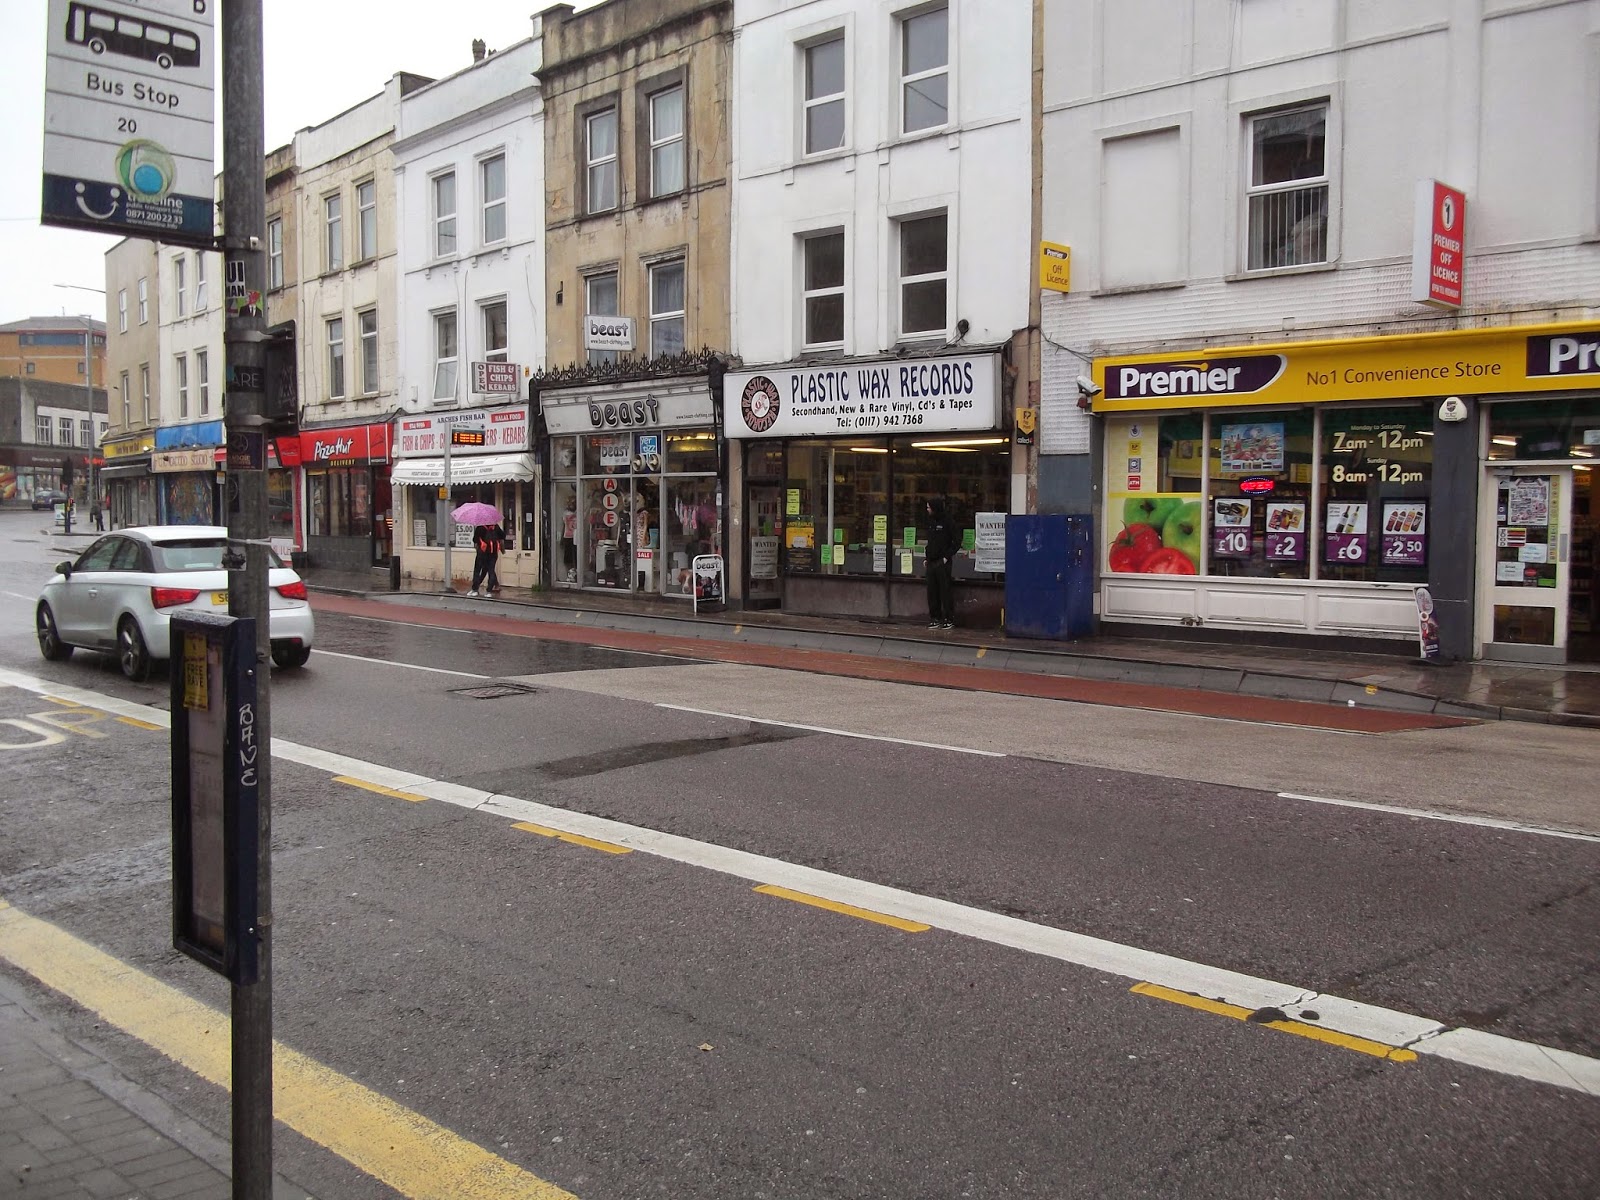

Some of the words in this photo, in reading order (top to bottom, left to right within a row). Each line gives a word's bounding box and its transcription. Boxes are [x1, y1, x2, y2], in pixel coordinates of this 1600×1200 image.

[87, 72, 124, 94] Bus
[133, 83, 179, 108] Stop
[117, 118, 137, 133] 20
[126, 209, 145, 219] 0871
[146, 211, 162, 221] 200
[1434, 234, 1460, 253] PREMIER
[1440, 252, 1452, 265] OFF
[1053, 265, 1062, 274] Off
[1433, 265, 1458, 284] LICENCE
[1047, 272, 1068, 286] Licence
[590, 319, 629, 337] beast
[478, 364, 486, 391] OPEN
[488, 365, 506, 373] FISH
[508, 365, 514, 373] &
[490, 374, 513, 382] CHIPS
[1307, 370, 1337, 386] No1
[1344, 365, 1449, 384] Convenience
[1455, 362, 1501, 378] Store
[488, 383, 516, 391] KEBABS
[791, 371, 849, 403] PLASTIC
[857, 368, 890, 399] WAX
[899, 362, 973, 398] RECORDS
[1120, 362, 1241, 397] Premier
[587, 393, 659, 428] beast
[791, 405, 838, 416] Secondhand,
[839, 404, 856, 414] New
[859, 404, 865, 413] &
[869, 402, 887, 413] Rare
[891, 401, 915, 414] Vinyl,
[917, 400, 935, 411] Cd's
[939, 400, 945, 410] &
[949, 398, 973, 411] Tapes
[837, 417, 851, 428] Tel:
[854, 416, 880, 428] (0117)
[884, 415, 899, 426] 942
[902, 414, 923, 425] 7368
[403, 435, 413, 451] FISH
[420, 433, 435, 450] CHIPS
[502, 426, 525, 444] KEBABS
[1377, 430, 1424, 450] 12pm
[314, 440, 335, 461] Pizza
[336, 437, 353, 455] Hut
[1332, 465, 1367, 482] 8am
[1377, 464, 1423, 485] 12pm
[1218, 533, 1247, 552] £10
[1275, 537, 1296, 556] £2
[1338, 538, 1362, 560] £6
[1386, 541, 1423, 557] £2.50
[187, 663, 203, 676] FREE
